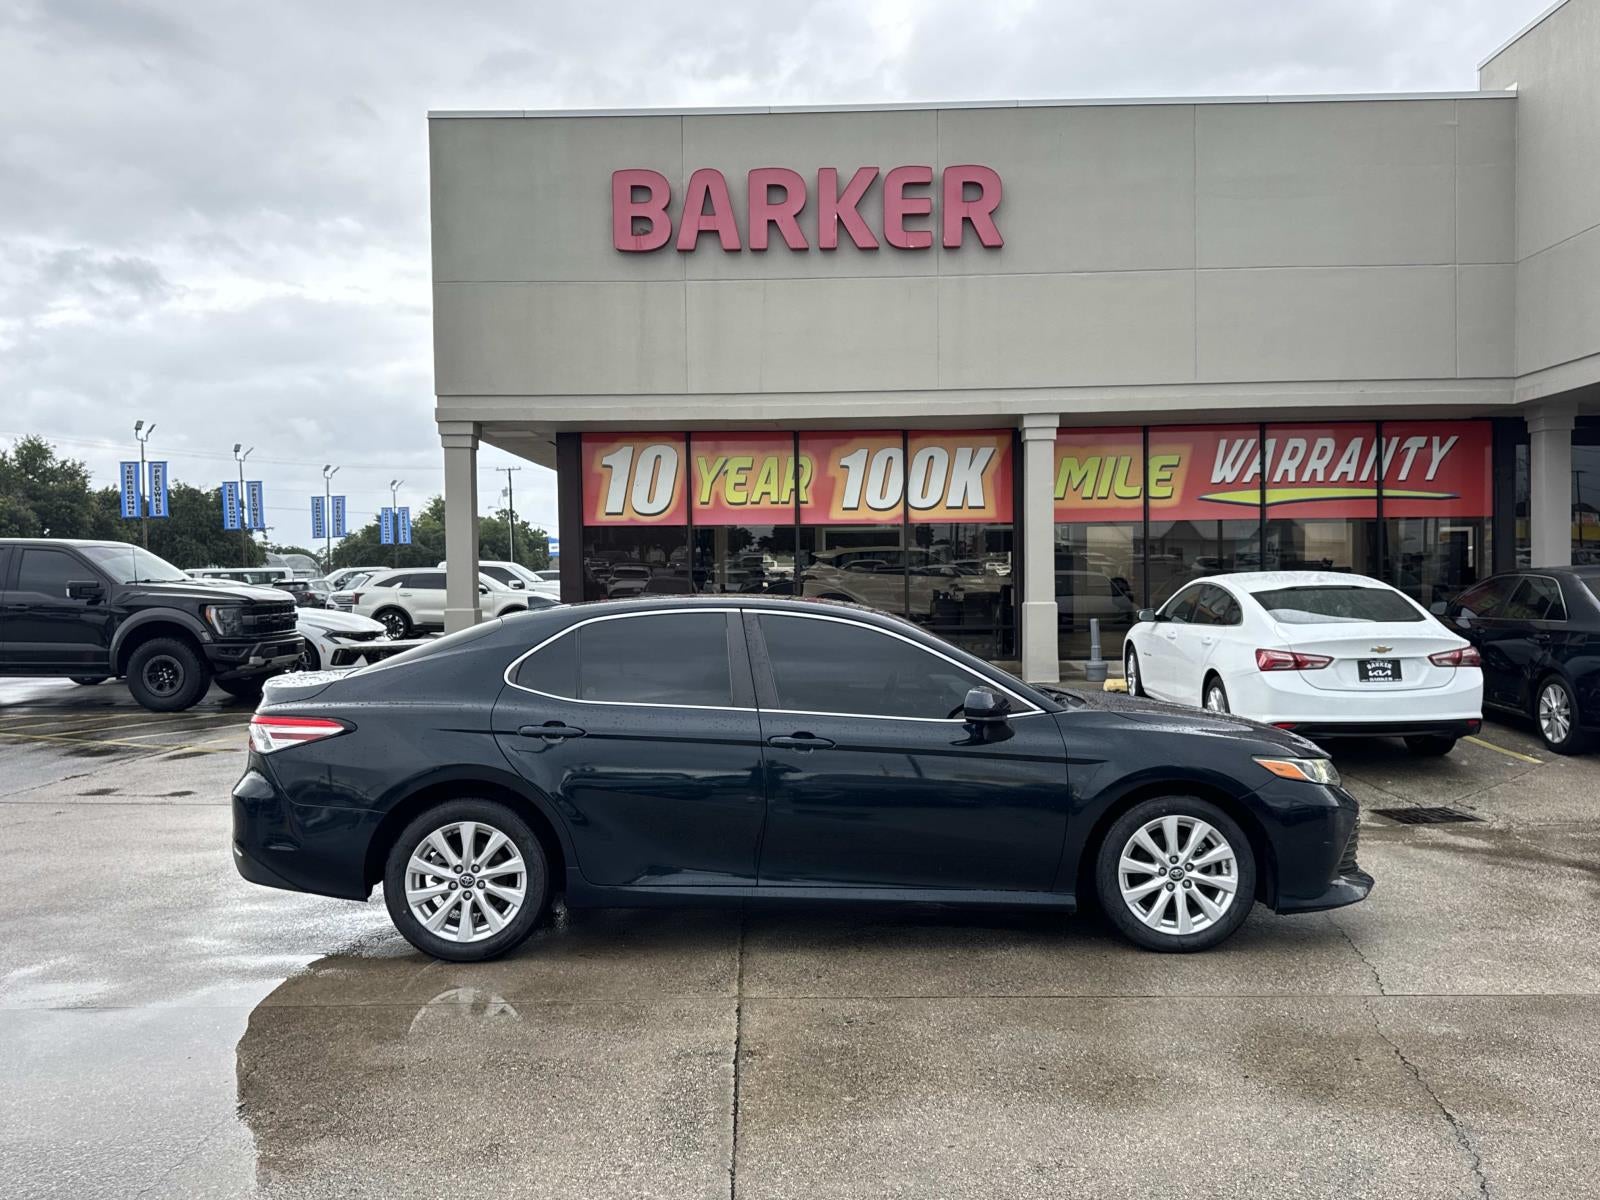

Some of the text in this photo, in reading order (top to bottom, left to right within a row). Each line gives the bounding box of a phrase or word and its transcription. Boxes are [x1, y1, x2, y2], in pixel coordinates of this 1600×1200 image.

[611, 165, 1005, 252] BARKER
[126, 464, 135, 514] TERREBONNE
[153, 469, 162, 515] PREOWNED
[601, 435, 1459, 516] 10 YEAR 100K MILE WARRANTY
